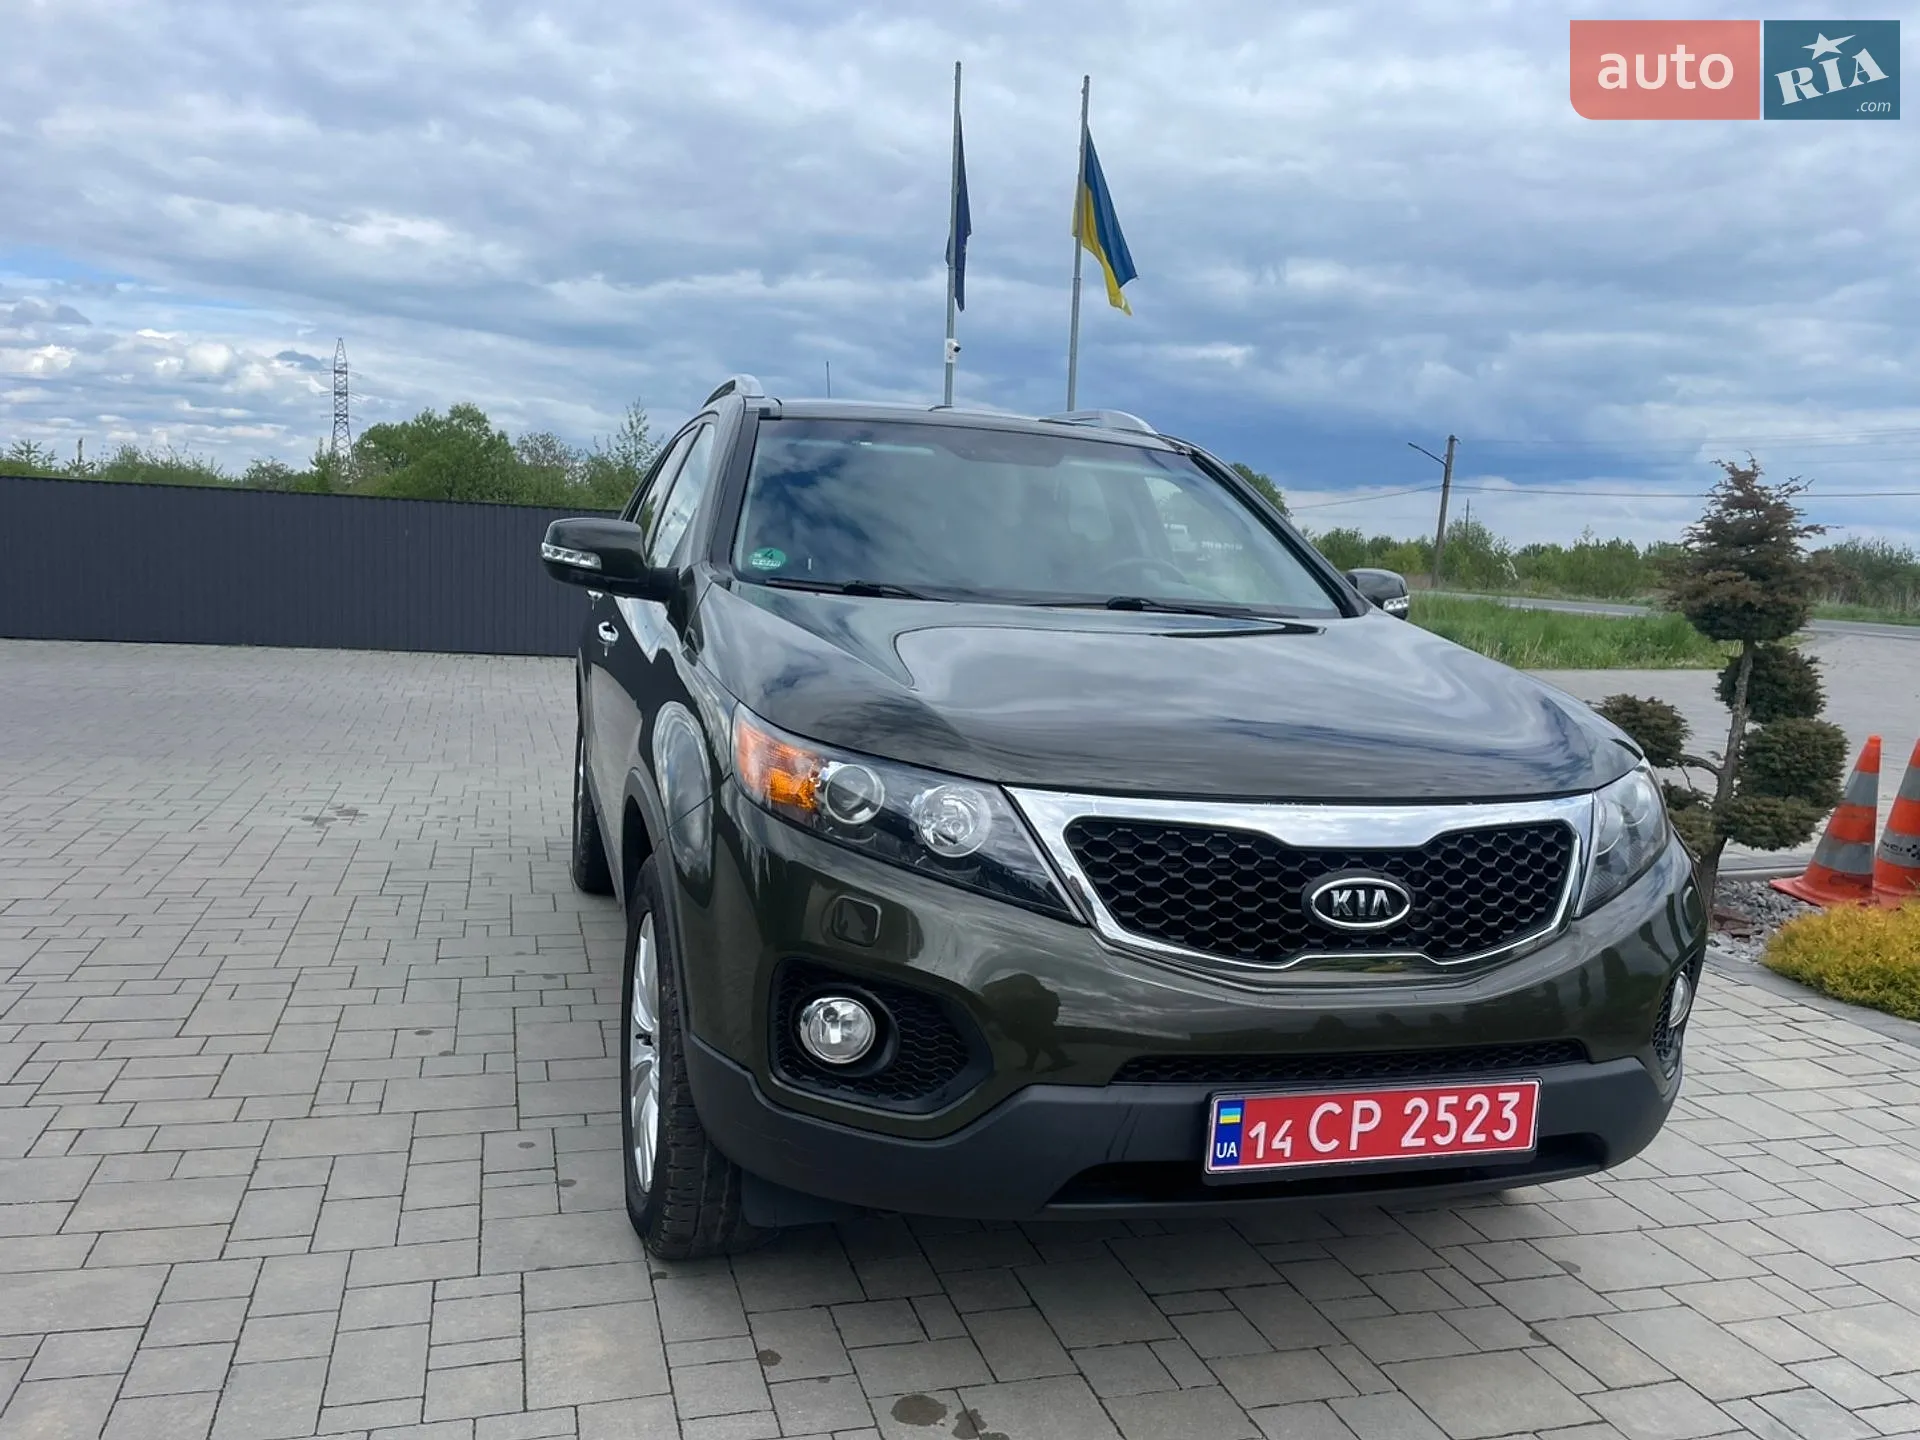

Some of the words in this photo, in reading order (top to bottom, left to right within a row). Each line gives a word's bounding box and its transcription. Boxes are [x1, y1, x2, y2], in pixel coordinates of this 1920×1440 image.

[1330, 889, 1392, 916] KIA
[1248, 1119, 1293, 1159] 14
[1308, 1100, 1382, 1152] CP
[1400, 1091, 1521, 1148] 2523
[1216, 1142, 1238, 1159] UA
